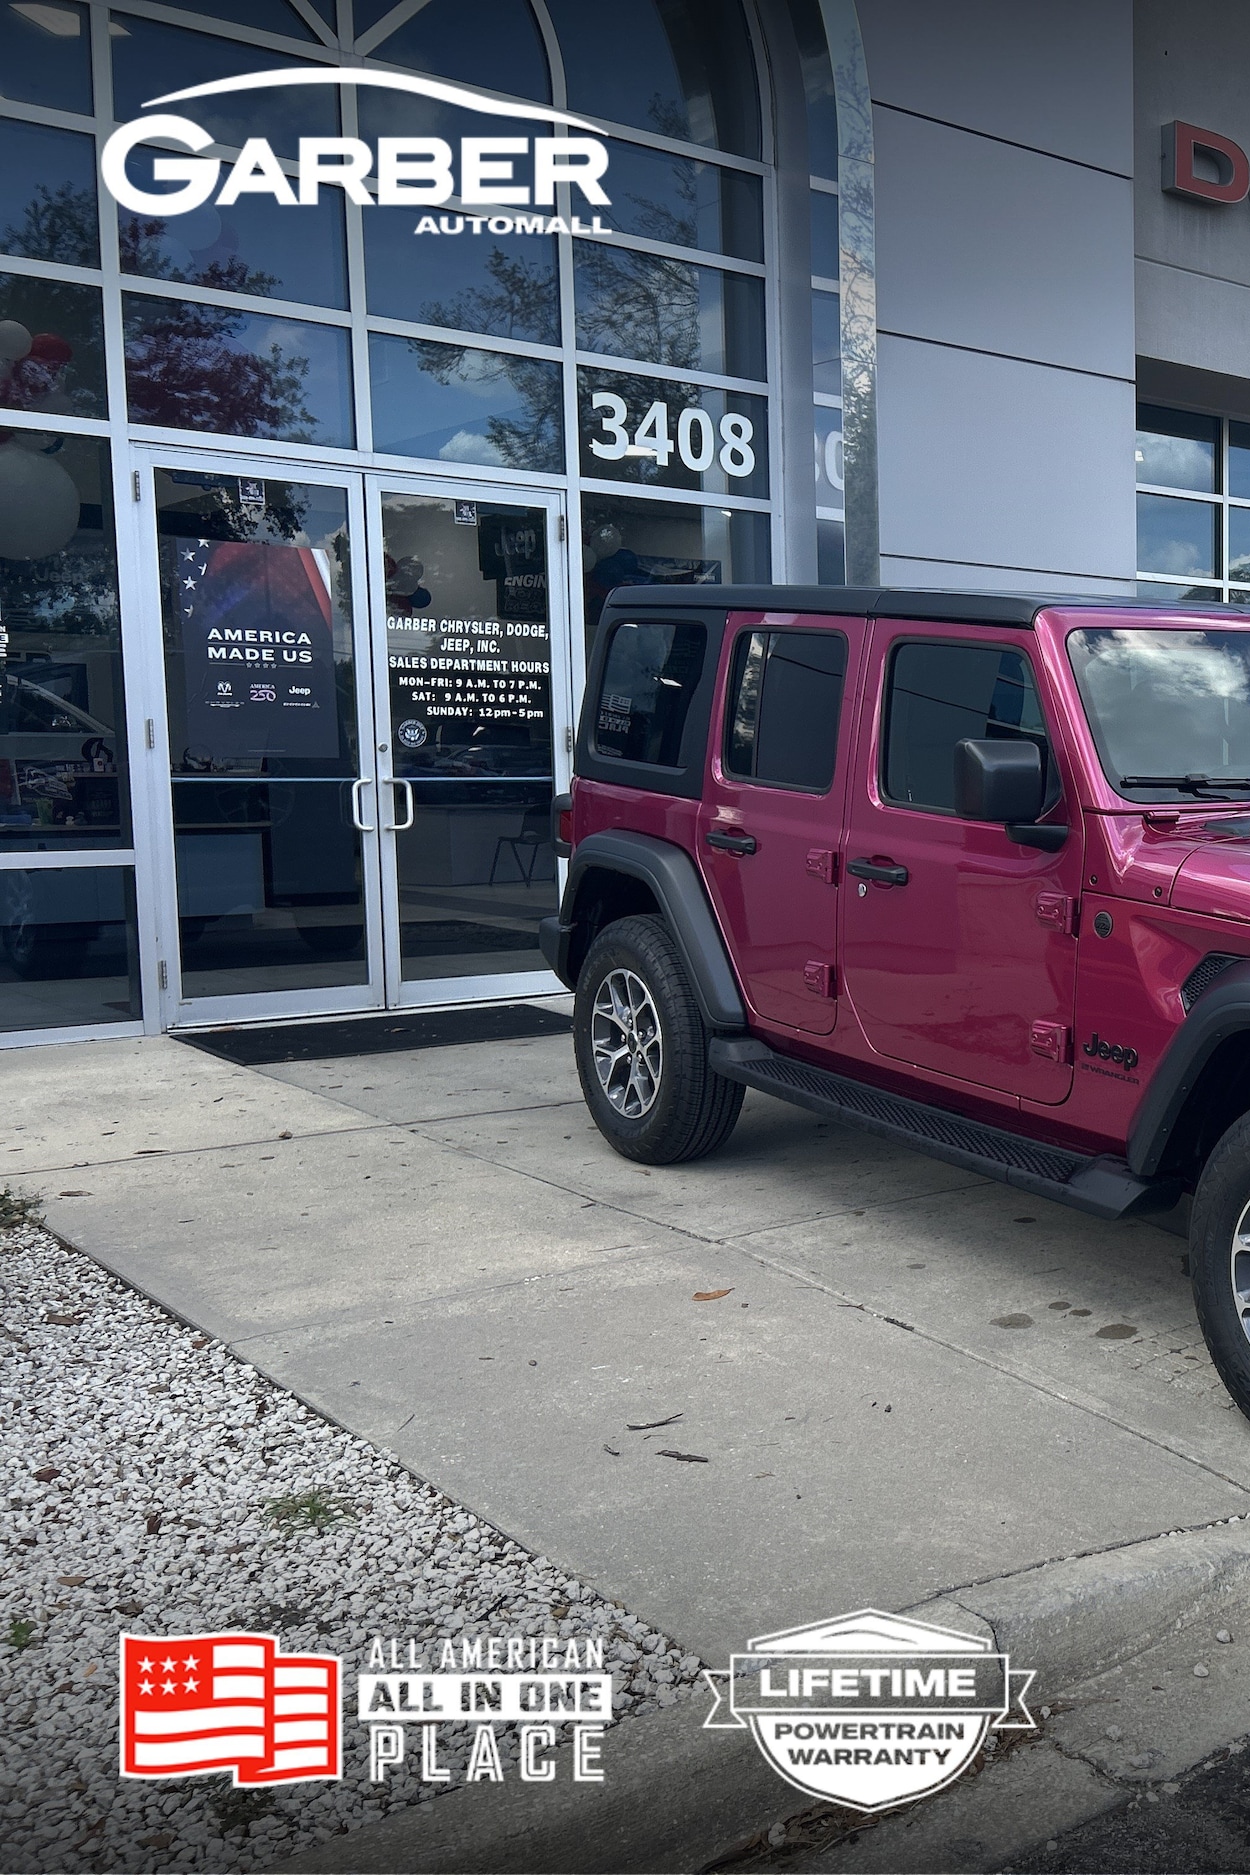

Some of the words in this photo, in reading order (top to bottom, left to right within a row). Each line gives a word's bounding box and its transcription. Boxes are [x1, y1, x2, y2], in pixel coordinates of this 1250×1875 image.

[591, 391, 755, 478] 3408
[207, 628, 312, 645] AMERICA
[387, 616, 436, 632] GARBER
[440, 619, 504, 638] CHRYSLER,
[506, 623, 549, 640] DODGE,
[207, 646, 275, 661] MADE
[283, 650, 313, 663] US
[440, 638, 474, 655] JEEP,
[477, 640, 501, 654] INC.
[389, 656, 427, 669] SALES
[430, 657, 508, 673] DEPARTMENT
[511, 660, 550, 673] HOURS
[288, 685, 311, 696] Jeep
[399, 676, 453, 688] MON-FRI:
[456, 679, 463, 688] 9
[466, 679, 490, 689] A.M.
[493, 680, 506, 689] TO
[509, 680, 516, 689] 7
[518, 680, 542, 690] P.M.
[250, 690, 277, 702] 250
[412, 691, 436, 701] SAT:
[445, 693, 452, 702] 9
[455, 693, 479, 702] A.M.
[482, 693, 496, 702] TO
[499, 694, 506, 703] 6
[508, 694, 532, 704] P.M.
[426, 706, 473, 716] SUNDAY:
[1083, 1032, 1139, 1071] Jeep
[1090, 1066, 1139, 1085] WRANGLER
